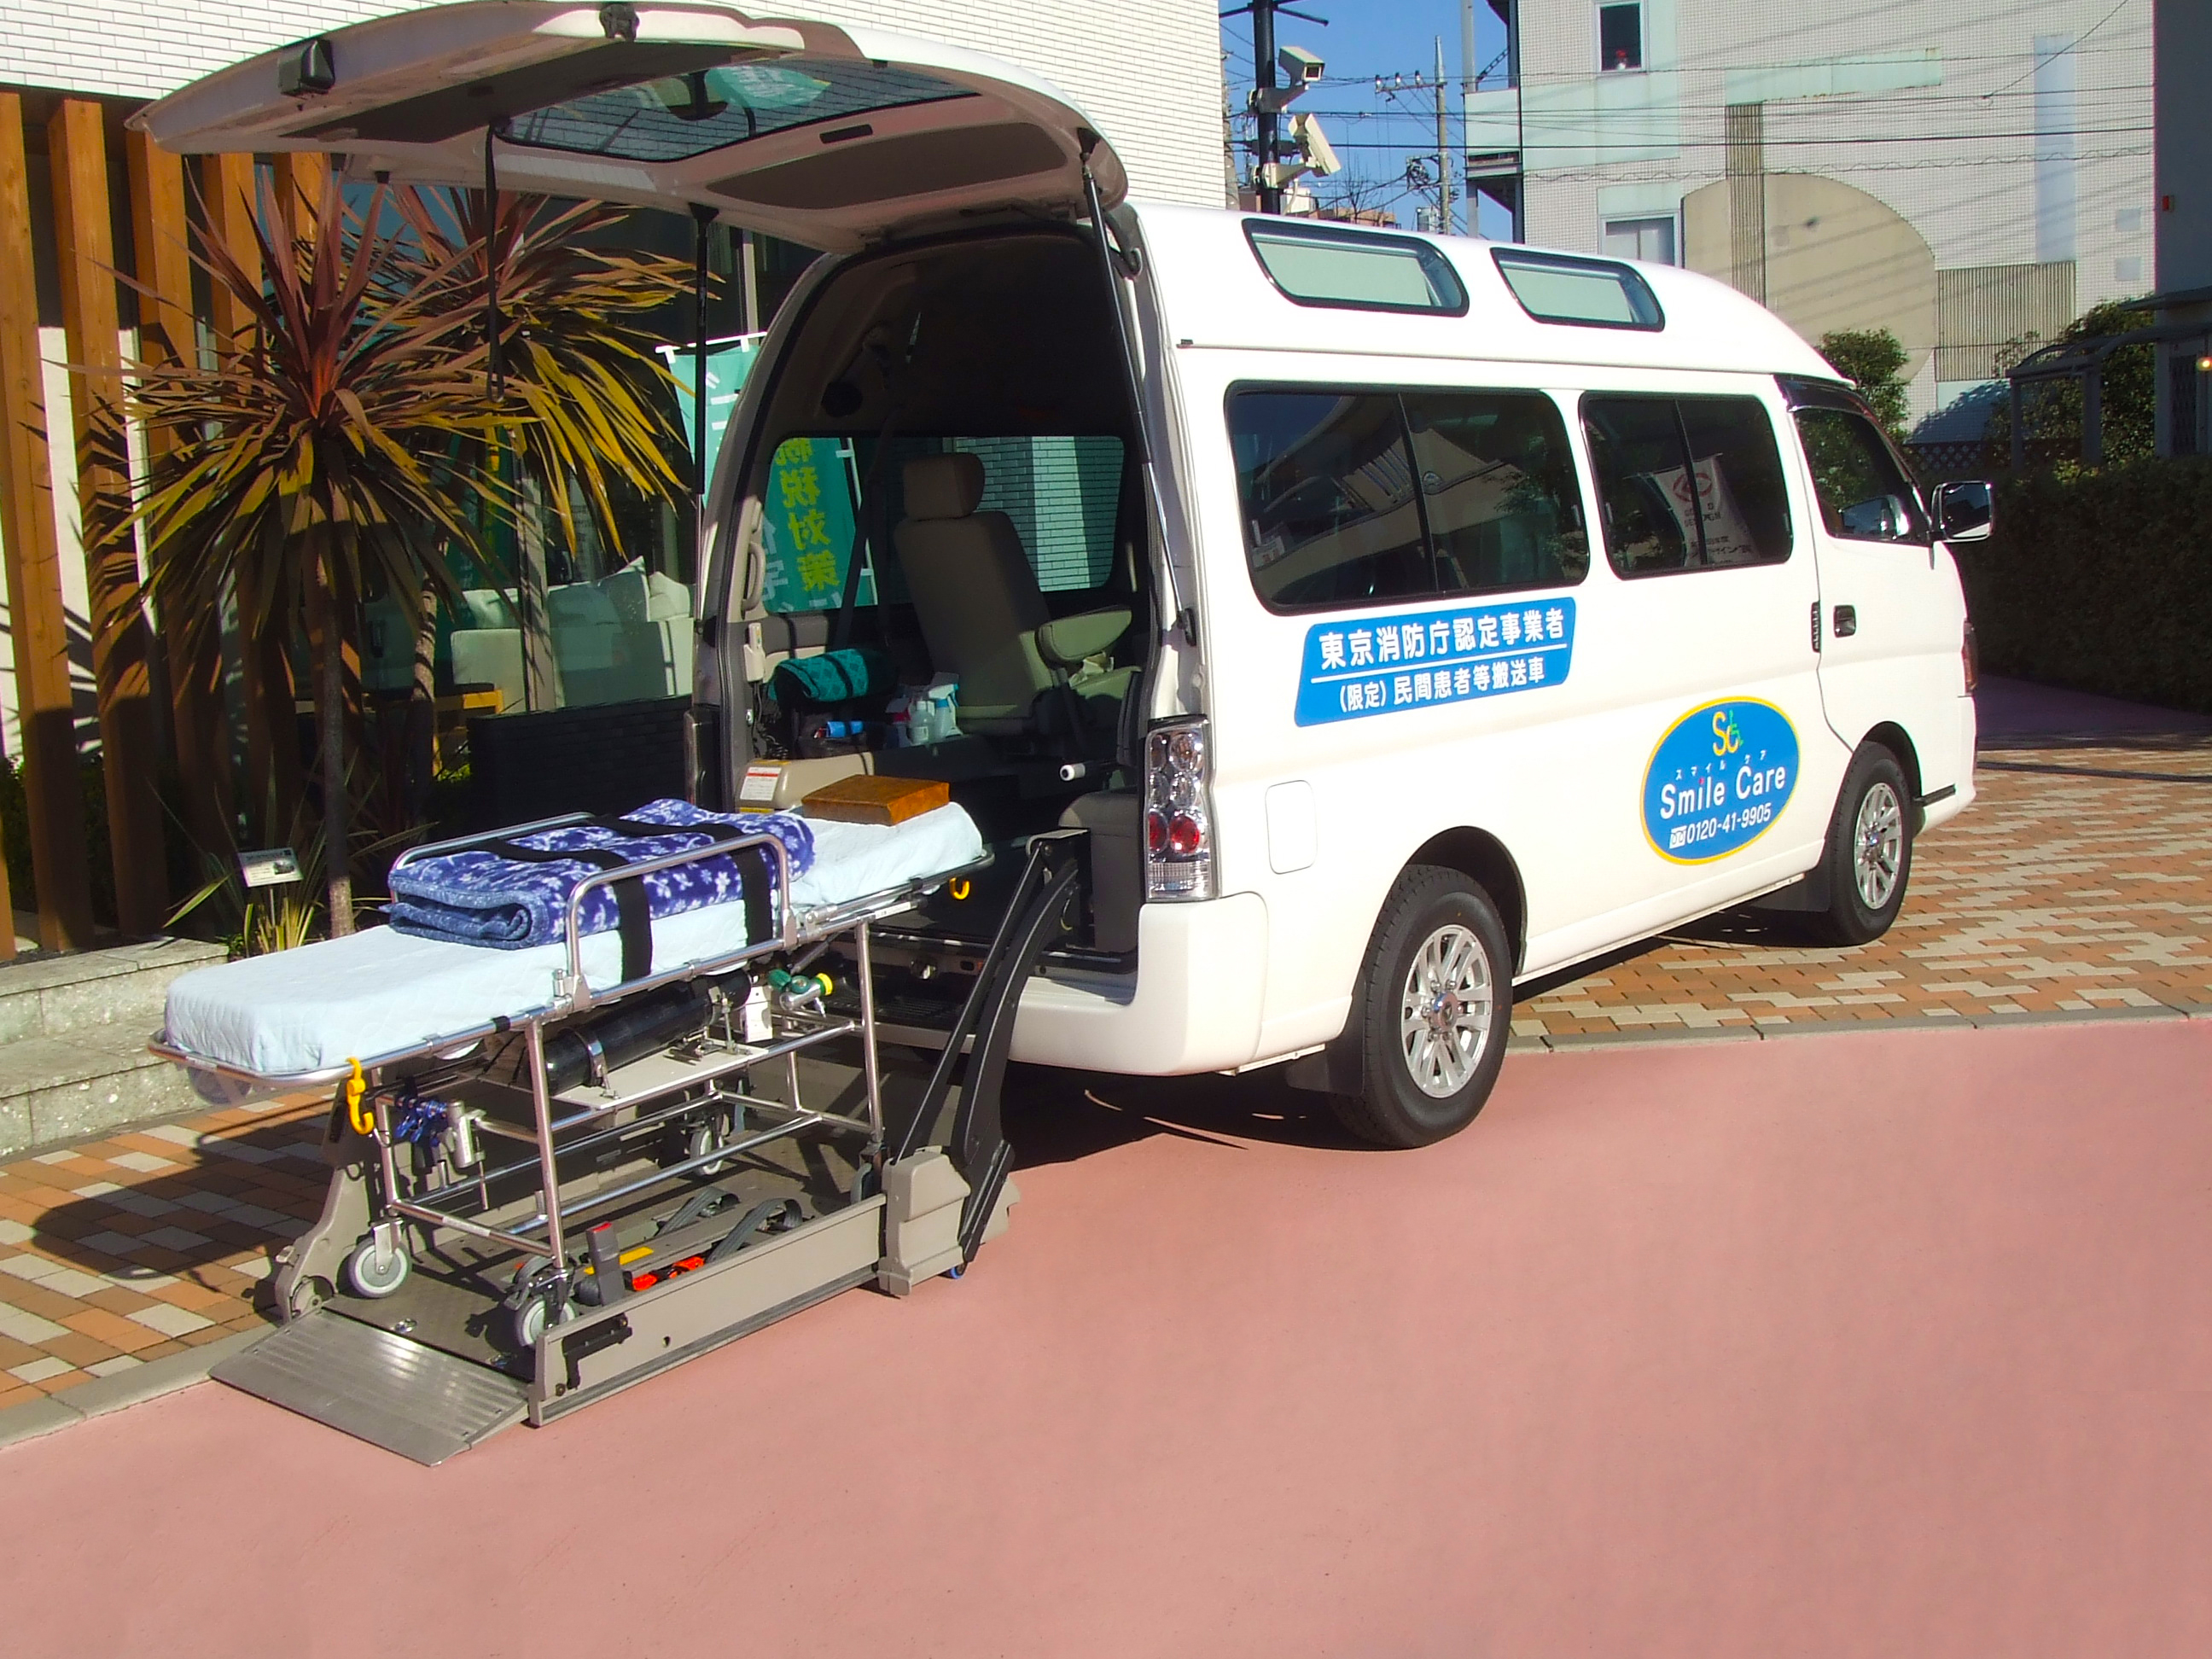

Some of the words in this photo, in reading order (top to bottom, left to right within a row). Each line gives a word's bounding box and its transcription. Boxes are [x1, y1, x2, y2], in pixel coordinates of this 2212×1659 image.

[1318, 608, 1564, 671] 東京消防庁認定事業者
[1660, 776, 1725, 819] Smile
[1736, 765, 1786, 800] Care
[1686, 802, 1772, 844] 0120-41-9905
